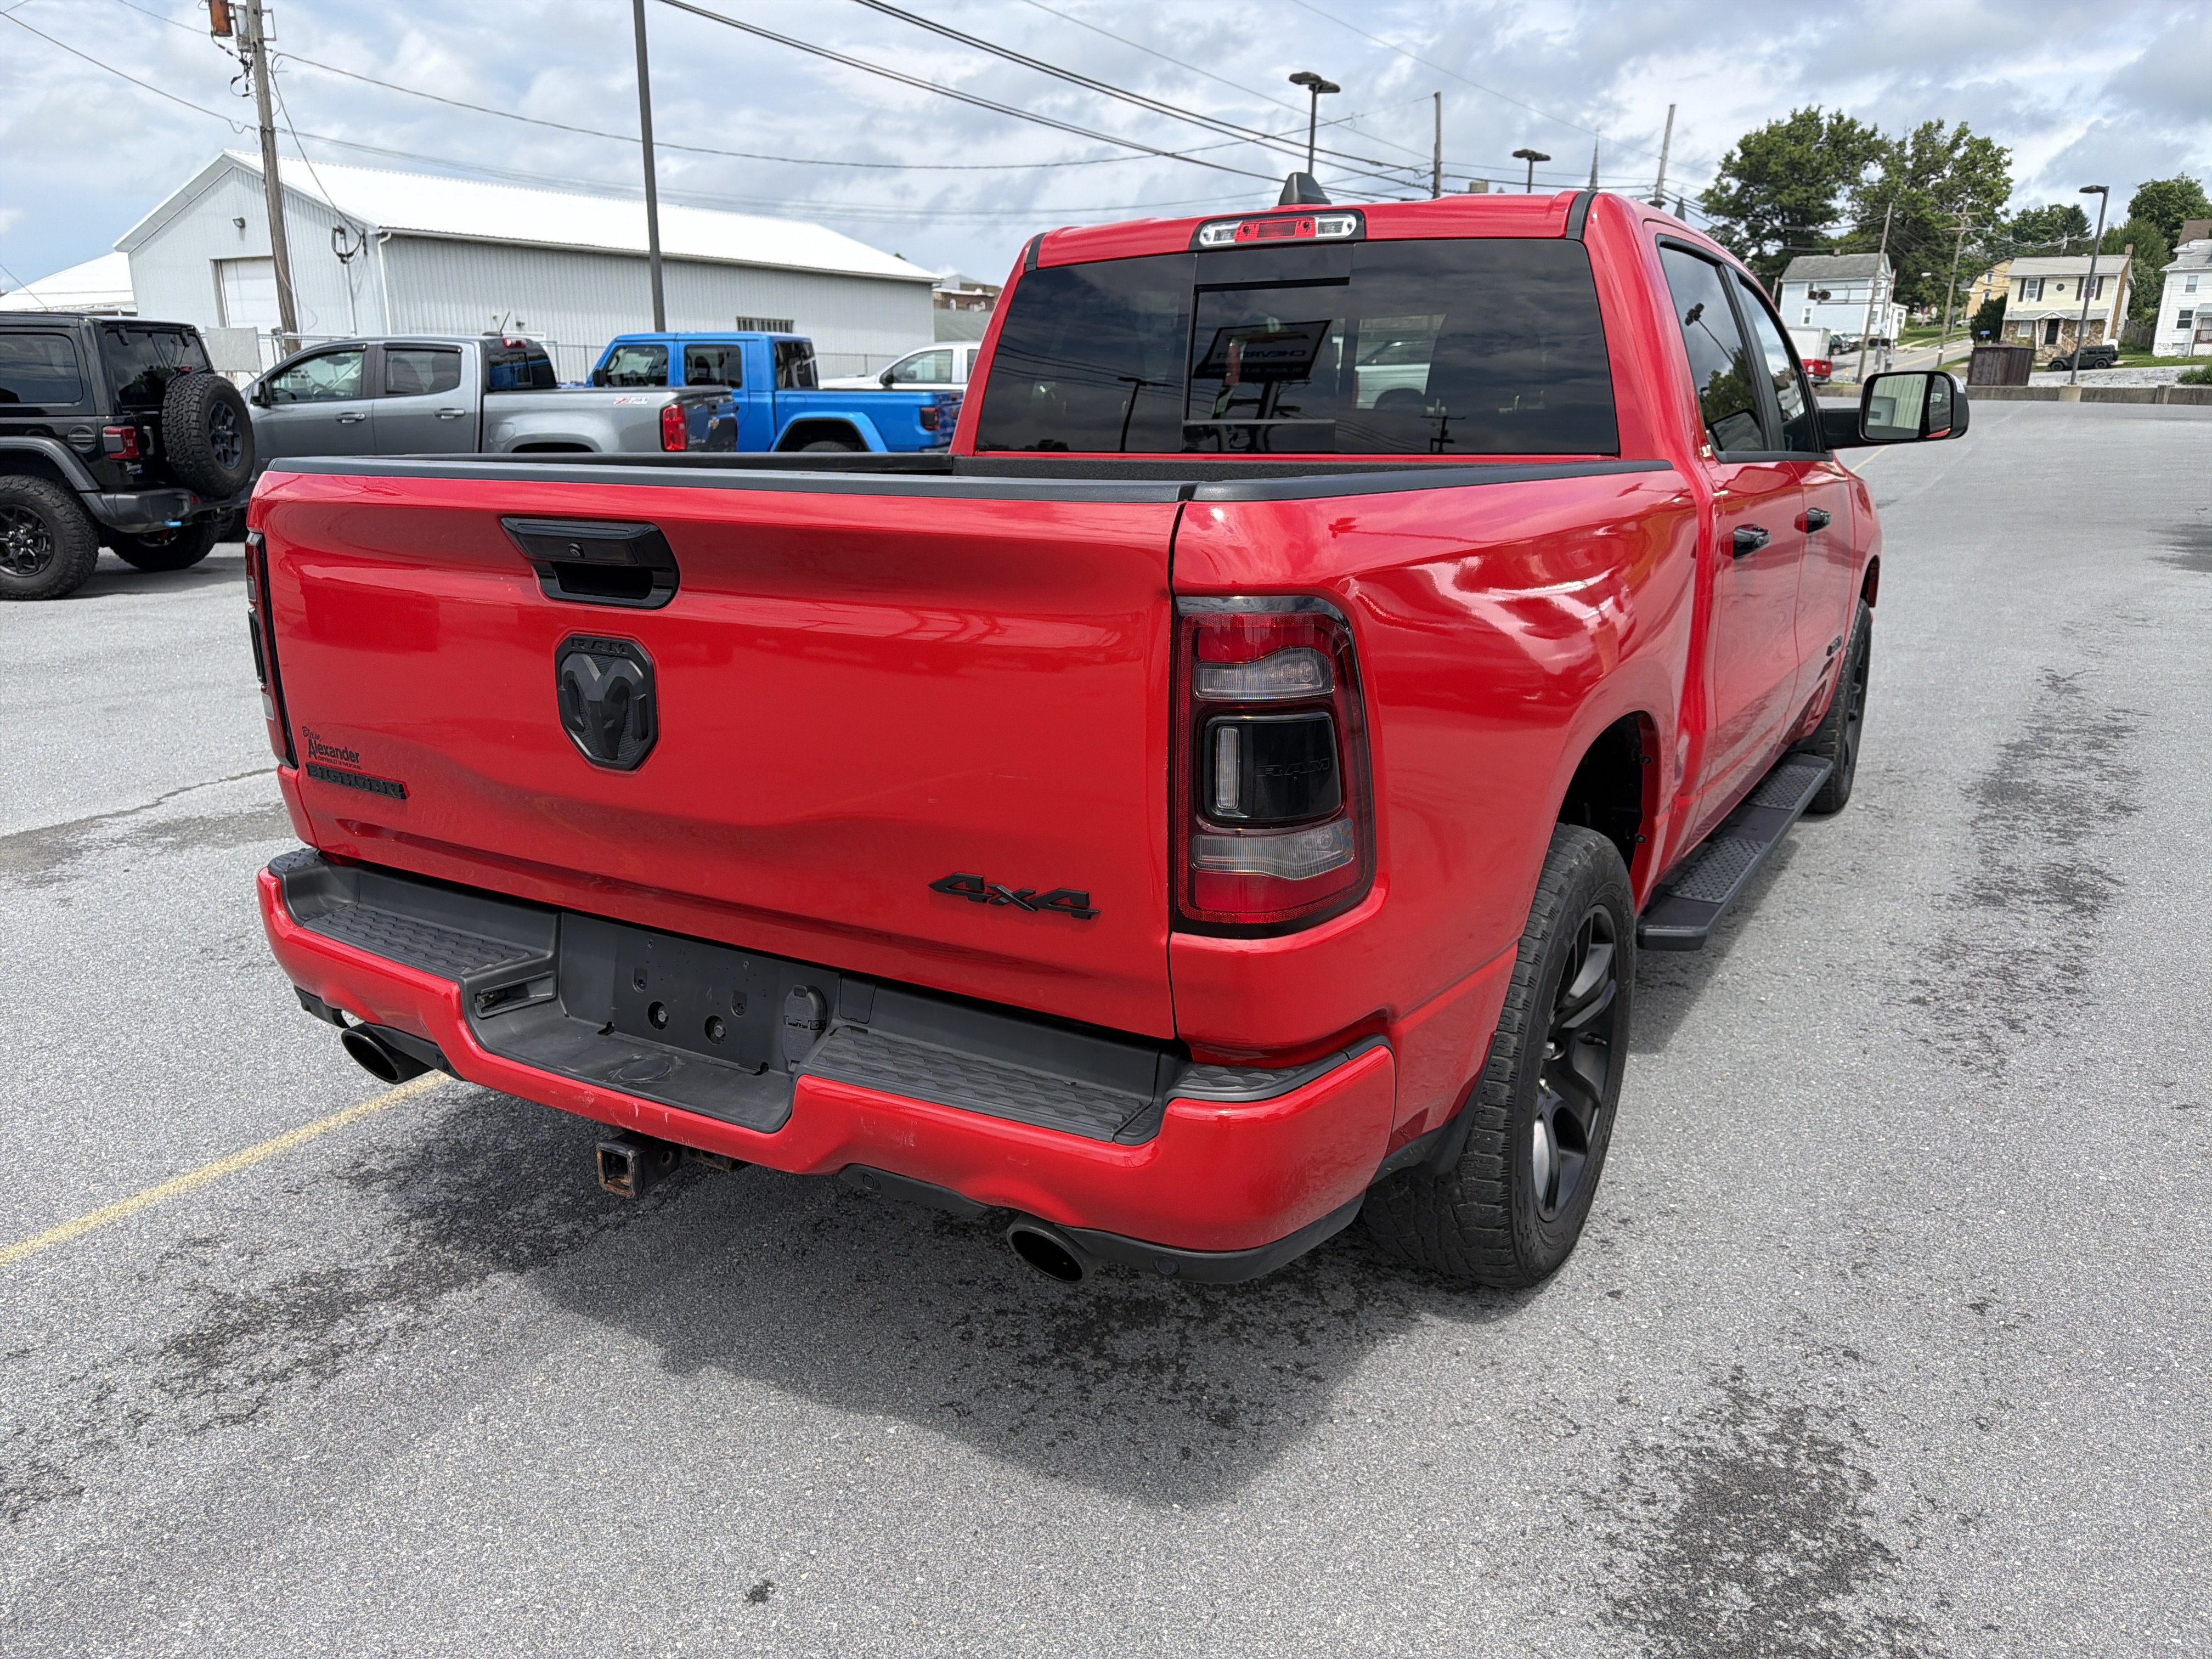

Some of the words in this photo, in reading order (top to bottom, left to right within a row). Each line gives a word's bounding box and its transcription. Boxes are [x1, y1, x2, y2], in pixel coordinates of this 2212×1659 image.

[571, 638, 628, 655] RAM
[308, 738, 360, 764] Alexander
[1256, 758, 1330, 777] RAM
